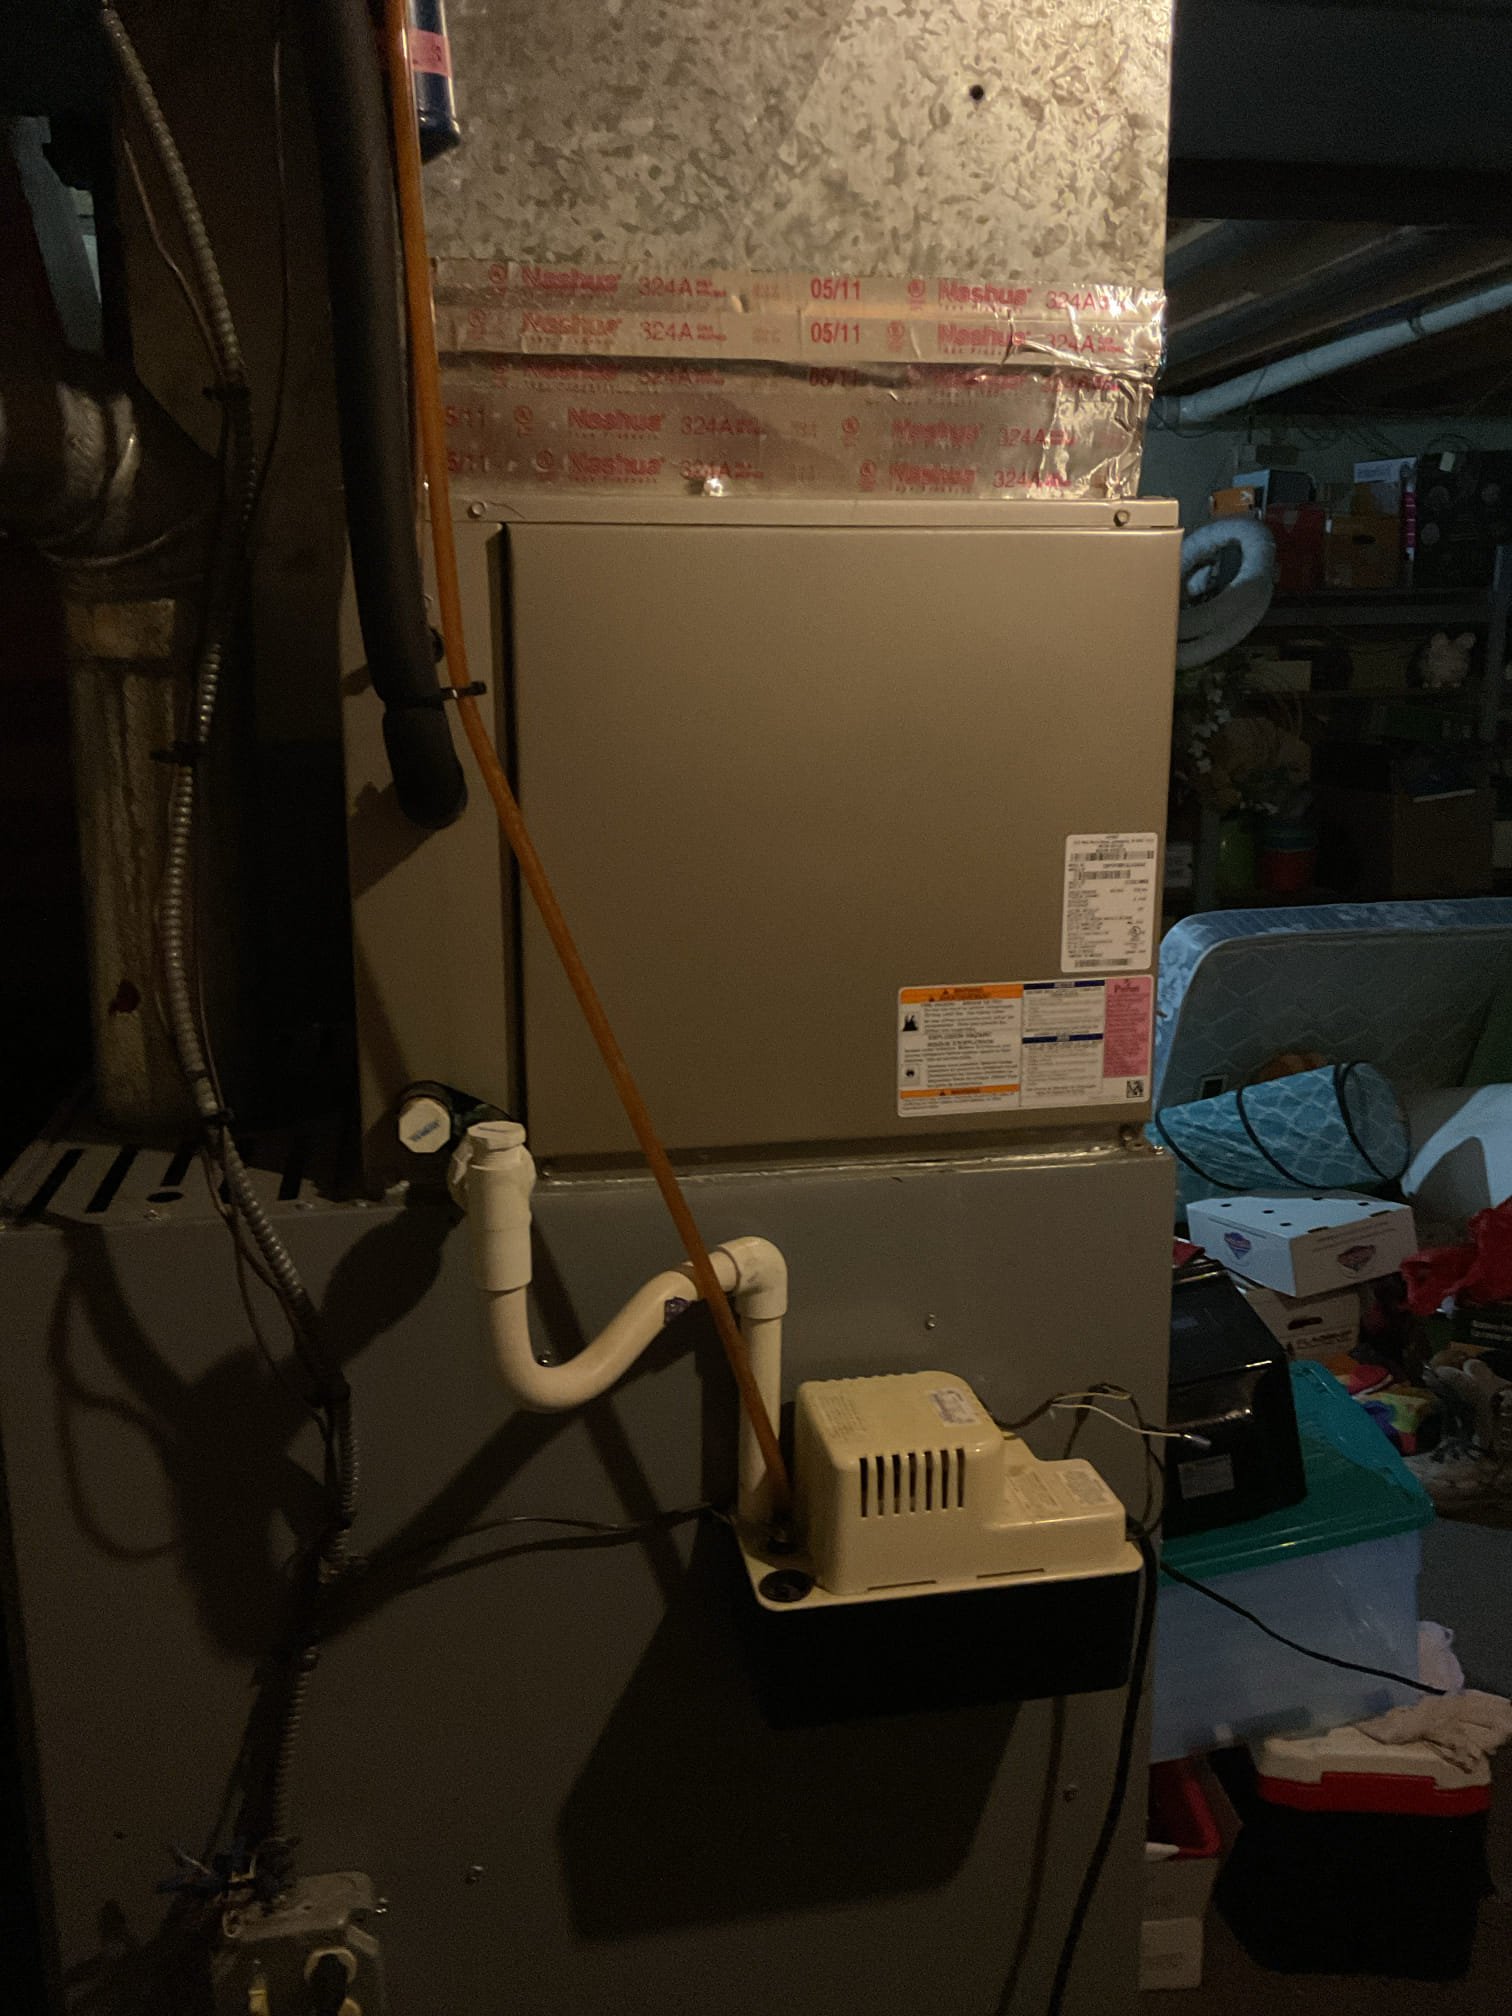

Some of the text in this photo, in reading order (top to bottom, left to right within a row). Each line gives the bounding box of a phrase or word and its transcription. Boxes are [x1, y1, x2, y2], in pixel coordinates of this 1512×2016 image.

[521, 267, 621, 291] Nashua
[638, 277, 694, 297] 324A
[809, 277, 861, 301] 05/11
[938, 280, 1030, 305] Nashua
[1045, 290, 1097, 311] 324A
[521, 312, 623, 337] Nashua
[640, 321, 694, 341] 324A
[809, 321, 861, 345] 05/11
[938, 324, 1031, 347] Nashua
[567, 407, 664, 431] Nashua
[681, 416, 736, 436] 324A
[567, 453, 664, 477] Nashua
